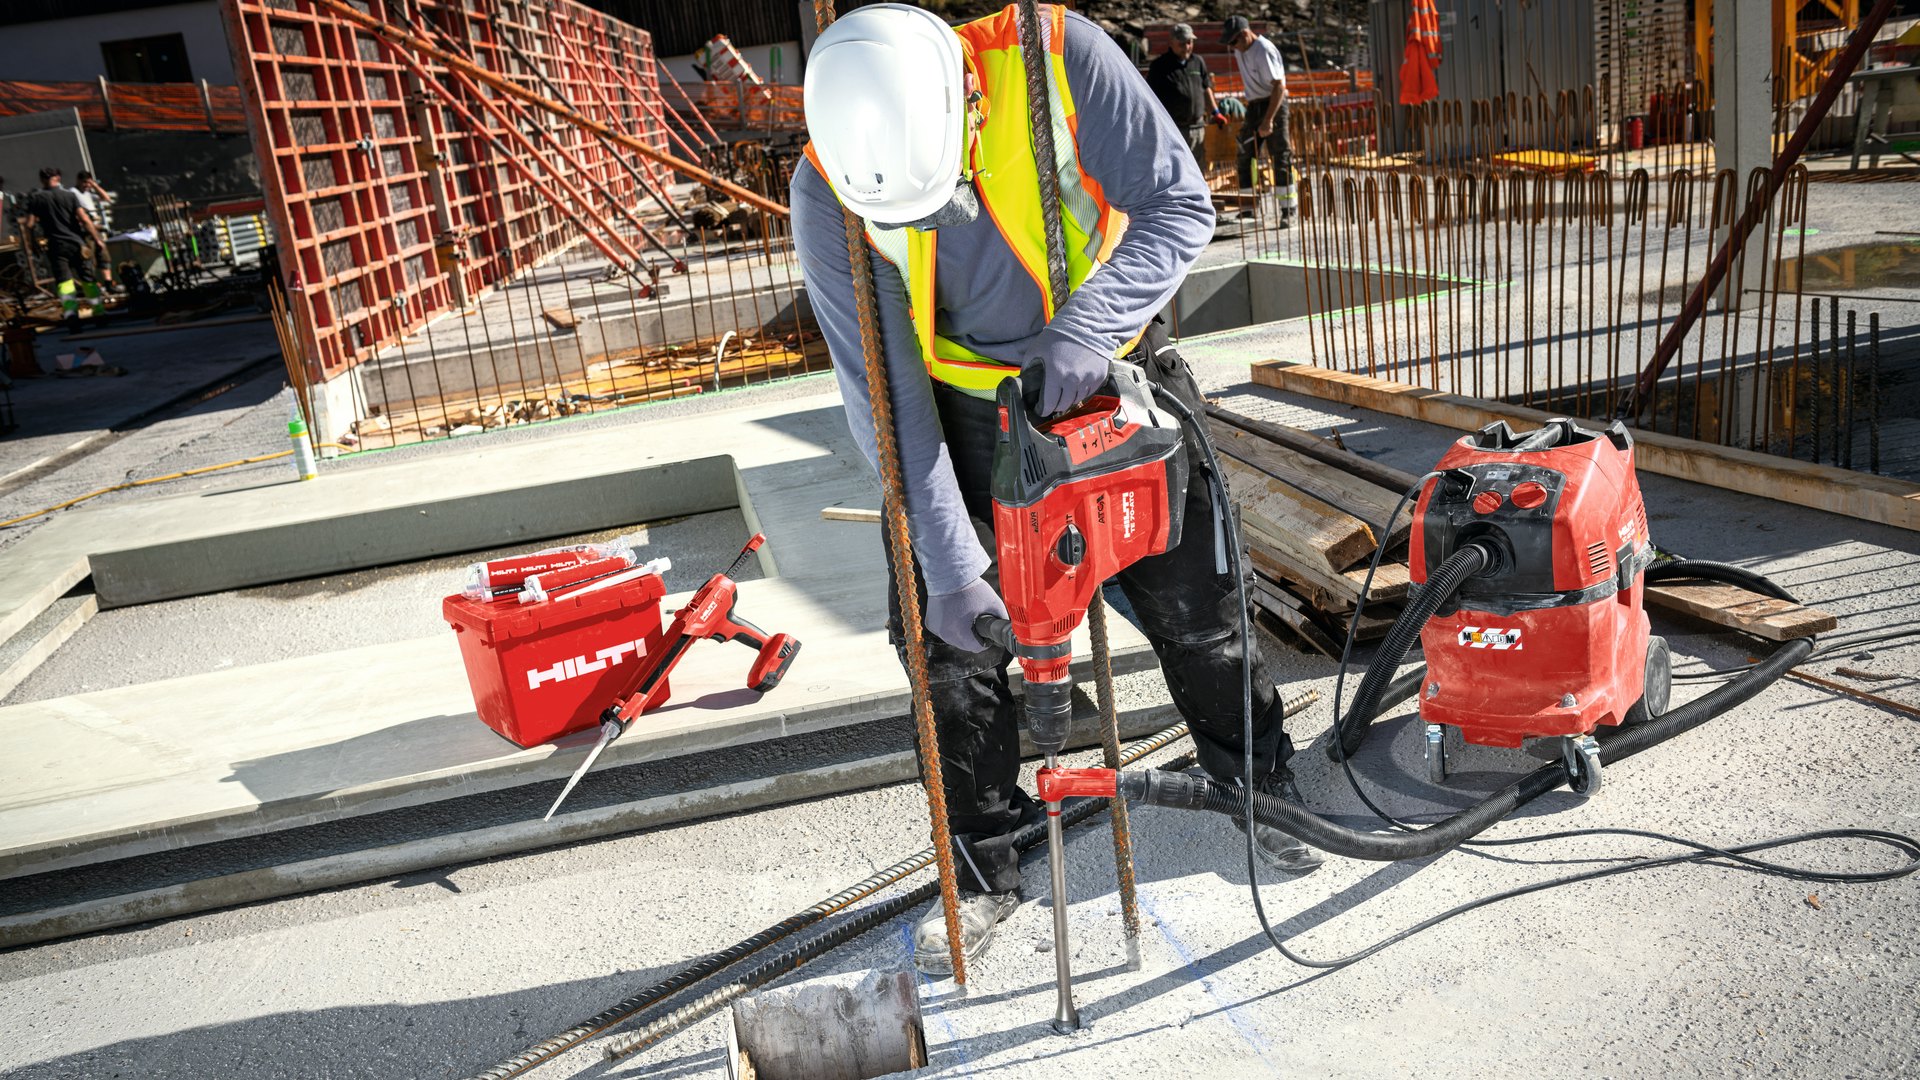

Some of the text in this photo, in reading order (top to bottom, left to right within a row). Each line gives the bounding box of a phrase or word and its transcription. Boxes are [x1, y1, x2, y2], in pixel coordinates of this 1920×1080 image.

[1122, 492, 1131, 538] HILTI
[1130, 522, 1136, 533] TE
[491, 568, 517, 576] HILTI
[521, 564, 547, 572] HILTI
[1463, 632, 1515, 644] M M
[527, 638, 647, 690] HILTI
